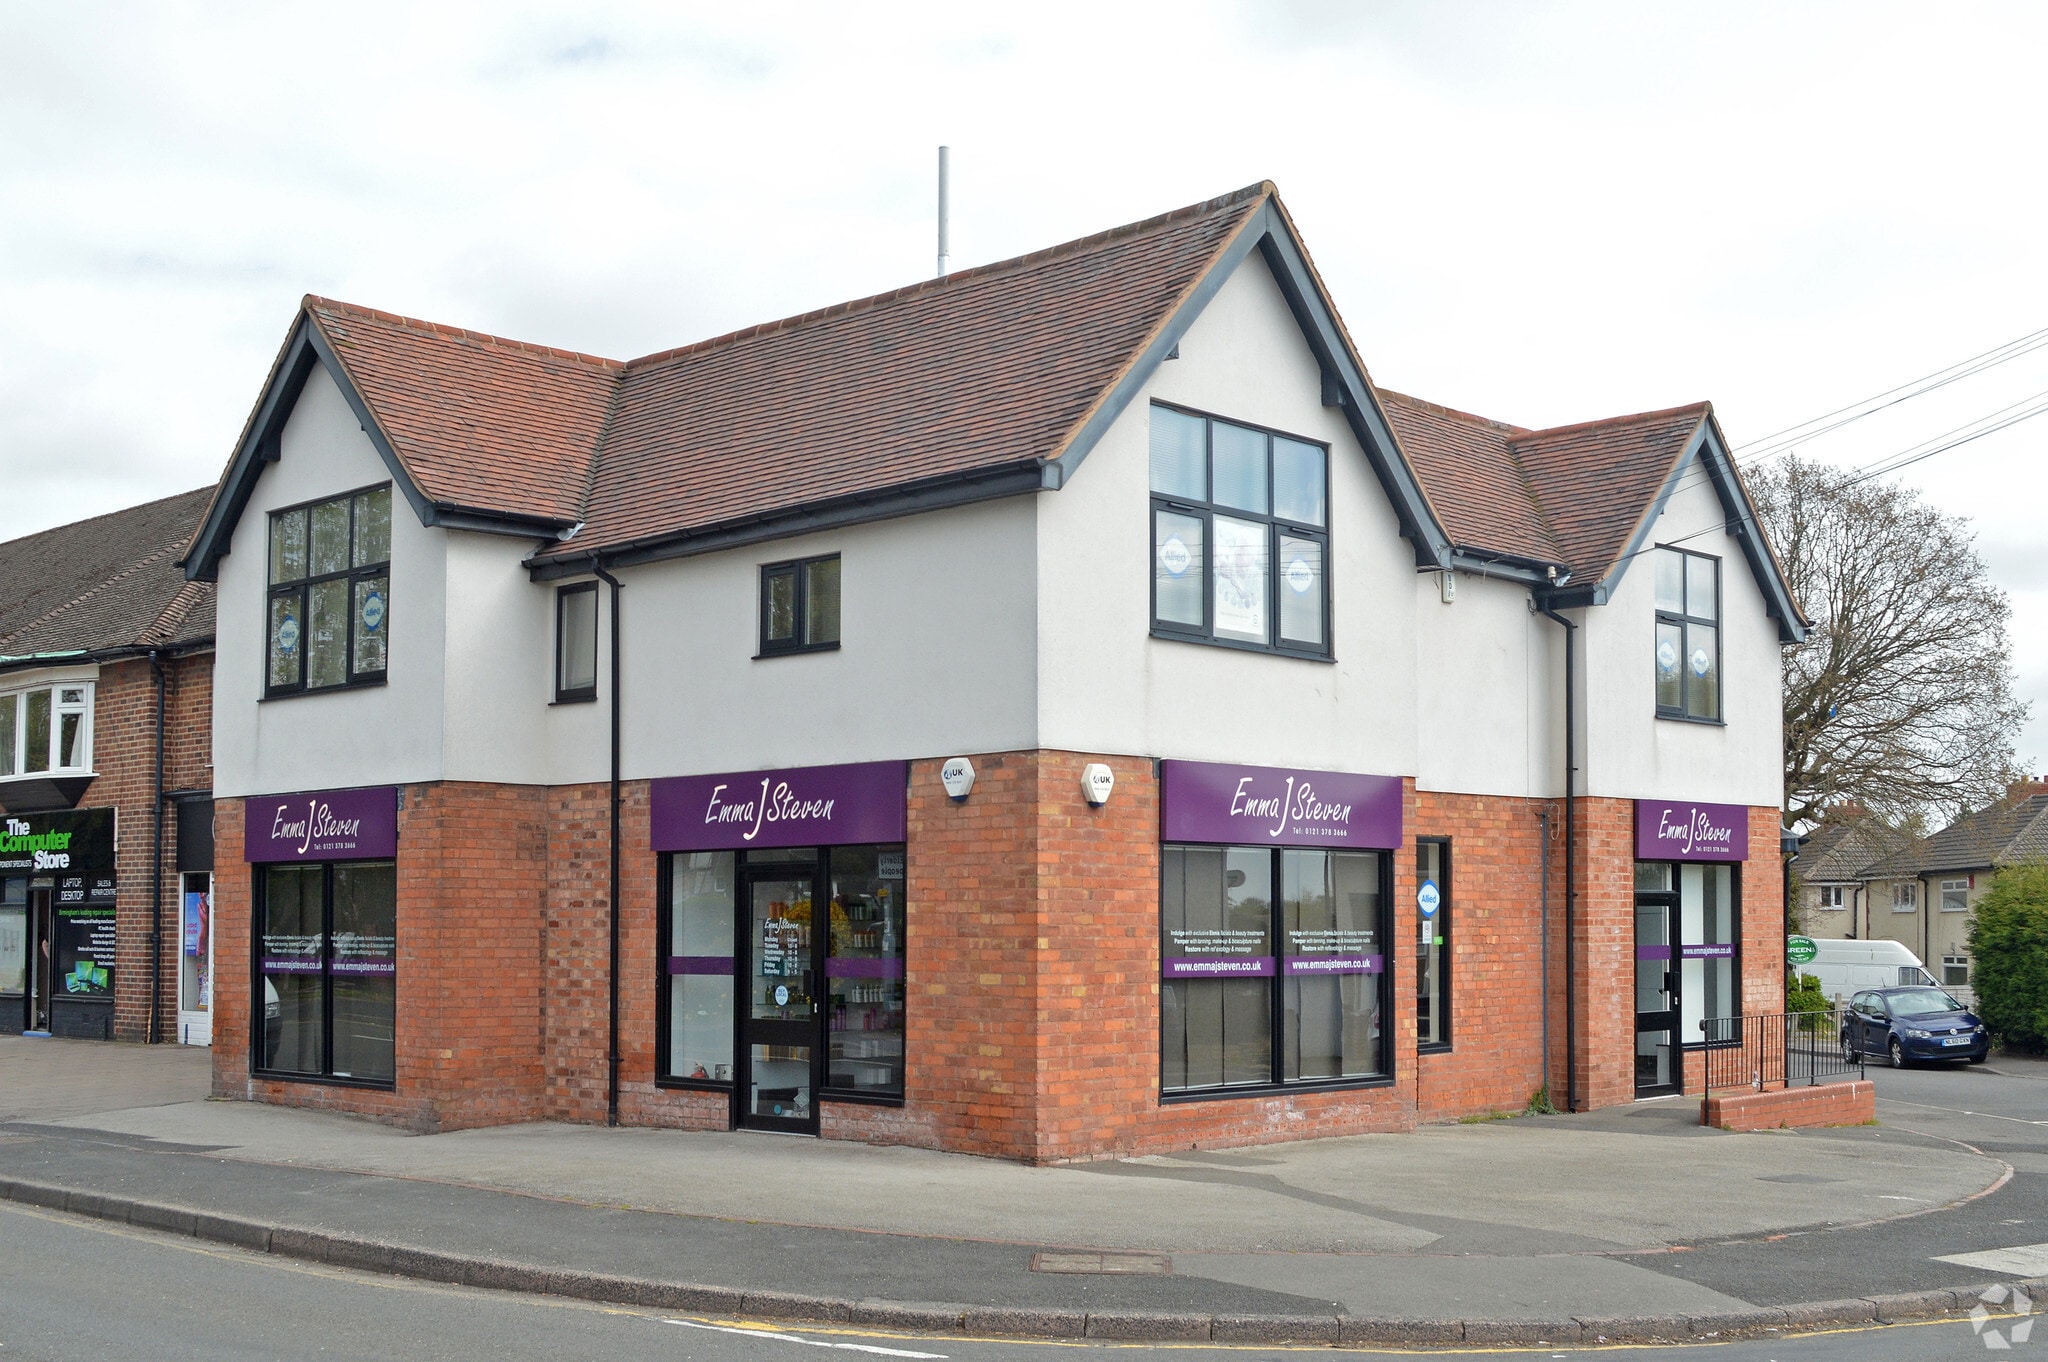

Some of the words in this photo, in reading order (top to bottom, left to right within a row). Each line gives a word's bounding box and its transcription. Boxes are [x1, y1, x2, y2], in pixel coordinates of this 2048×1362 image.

[1165, 550, 1186, 562] Allied
[1100, 776, 1110, 784] UK
[705, 784, 754, 824] Emma
[743, 778, 769, 840] J
[767, 782, 834, 822] Steven
[1230, 777, 1280, 818] Emma
[1270, 776, 1294, 837] J
[1292, 782, 1352, 824] Steven
[6, 818, 30, 836] The
[272, 804, 305, 839] Emma
[298, 800, 316, 854] J
[314, 804, 360, 838] Steven
[1658, 809, 1688, 840] Emma
[1682, 808, 1696, 854] J
[1694, 812, 1732, 843] Steven
[0, 828, 72, 856] Computer
[34, 850, 70, 869] Store
[61, 890, 84, 900] DESKTOP
[1422, 894, 1436, 903] Allied
[333, 962, 395, 972] www.emmajsteven.co.uk
[1174, 961, 1261, 973] www.emmajsteven.co.uk
[1292, 959, 1370, 970] www.emmajsteven.co.uk
